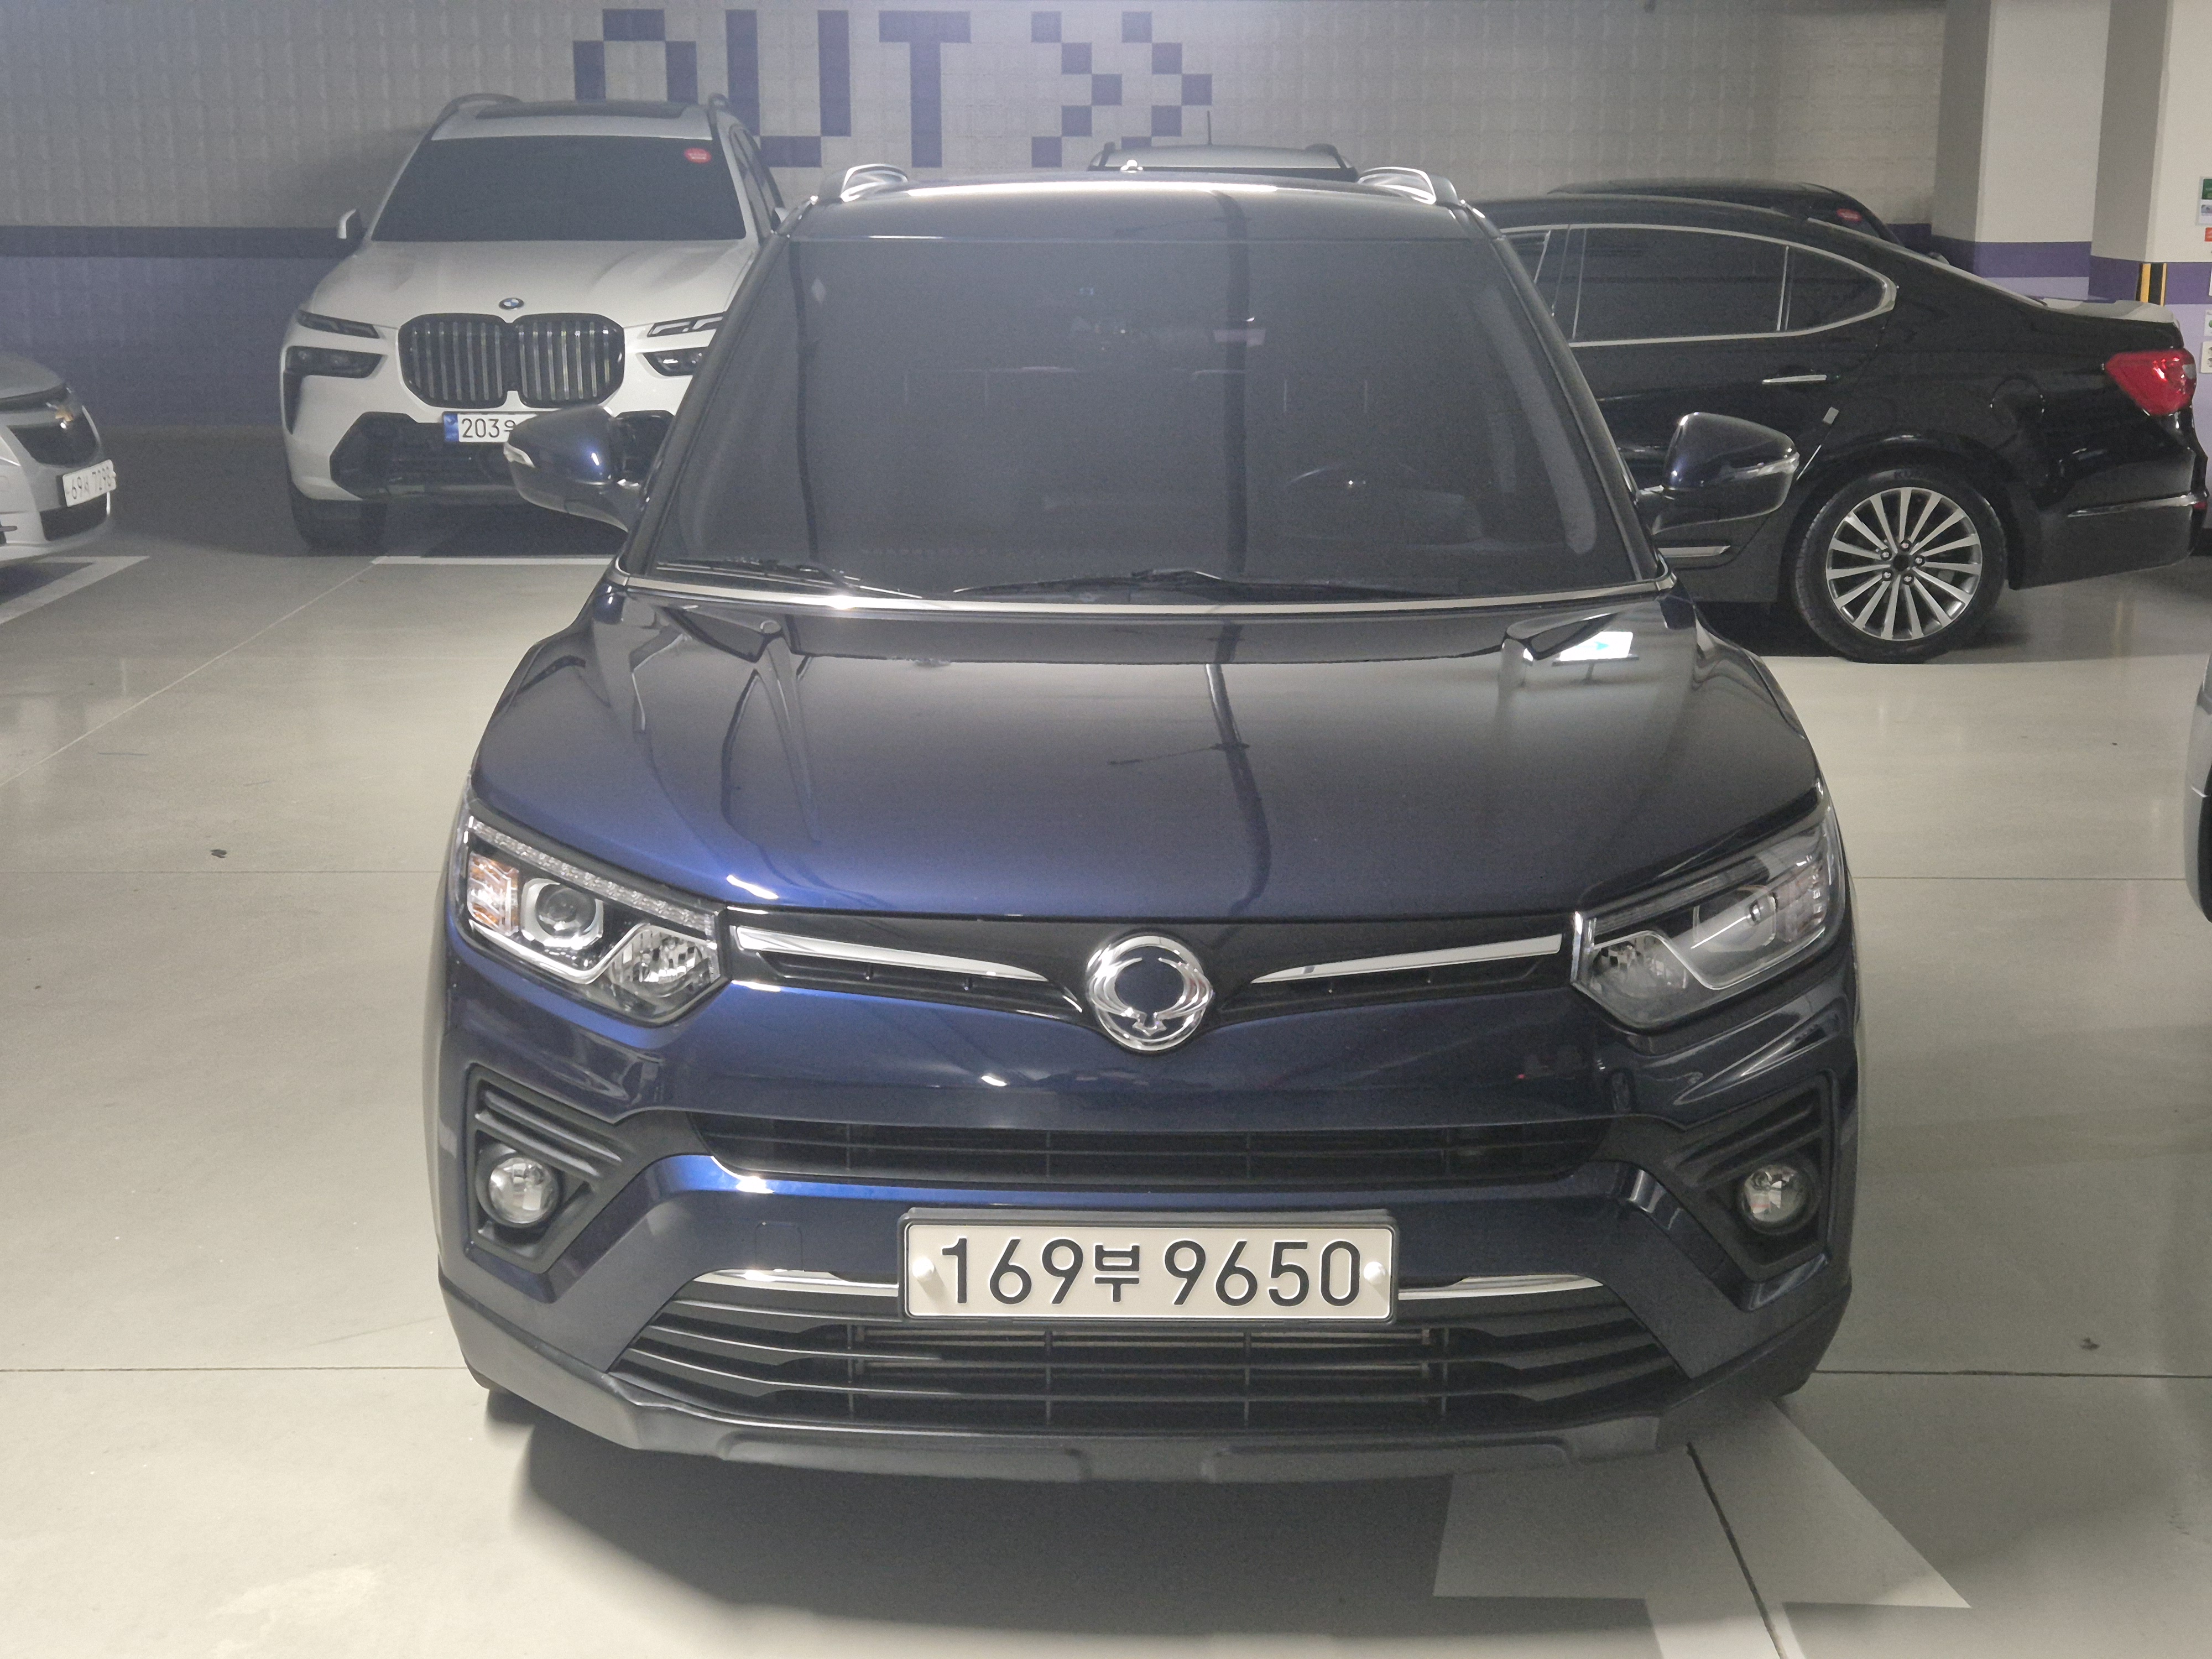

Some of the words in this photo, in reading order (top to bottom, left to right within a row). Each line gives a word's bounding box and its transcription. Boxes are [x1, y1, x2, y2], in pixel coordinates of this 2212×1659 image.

[573, 9, 971, 168] OUT
[942, 1238, 1140, 1305] 169부
[1164, 1240, 1360, 1307] 9650
